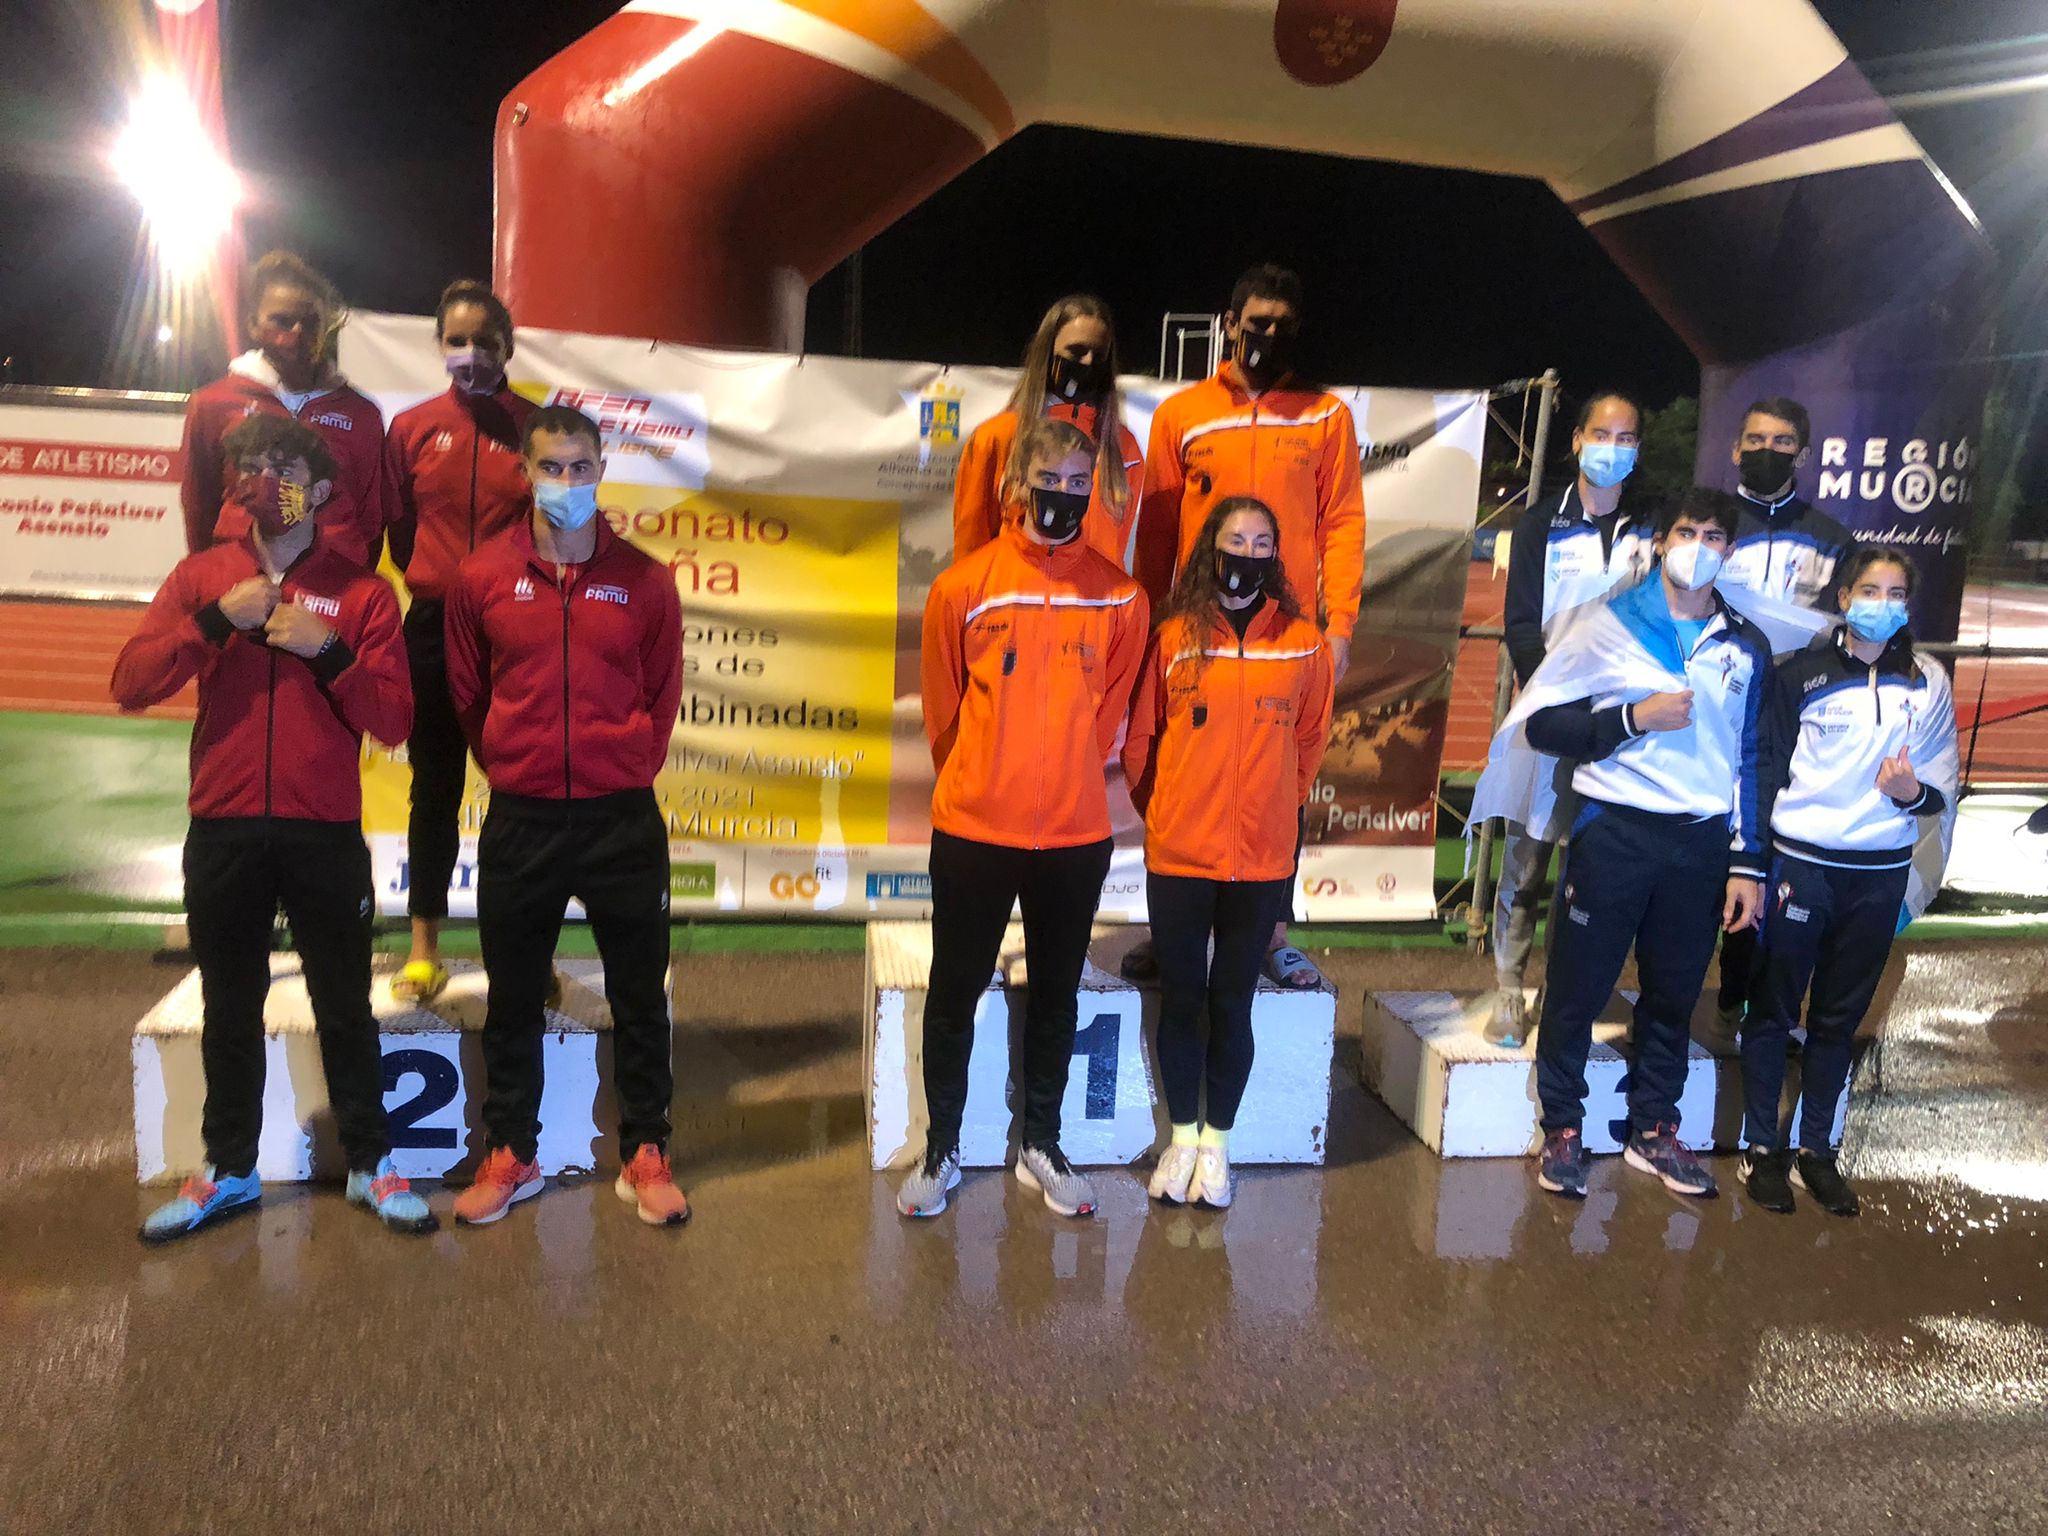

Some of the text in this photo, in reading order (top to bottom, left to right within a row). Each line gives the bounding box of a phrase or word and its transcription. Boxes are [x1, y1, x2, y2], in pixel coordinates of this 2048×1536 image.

[32, 448, 171, 478] ATLETISMO
[584, 588, 629, 605] FAMU
[715, 653, 765, 678] de
[680, 695, 859, 731] binadas
[668, 809, 799, 839] Murcia
[1327, 803, 1432, 832] Peñalver
[769, 866, 833, 900] GO fit
[1073, 1014, 1121, 1120] 1
[382, 1049, 459, 1149] 2
